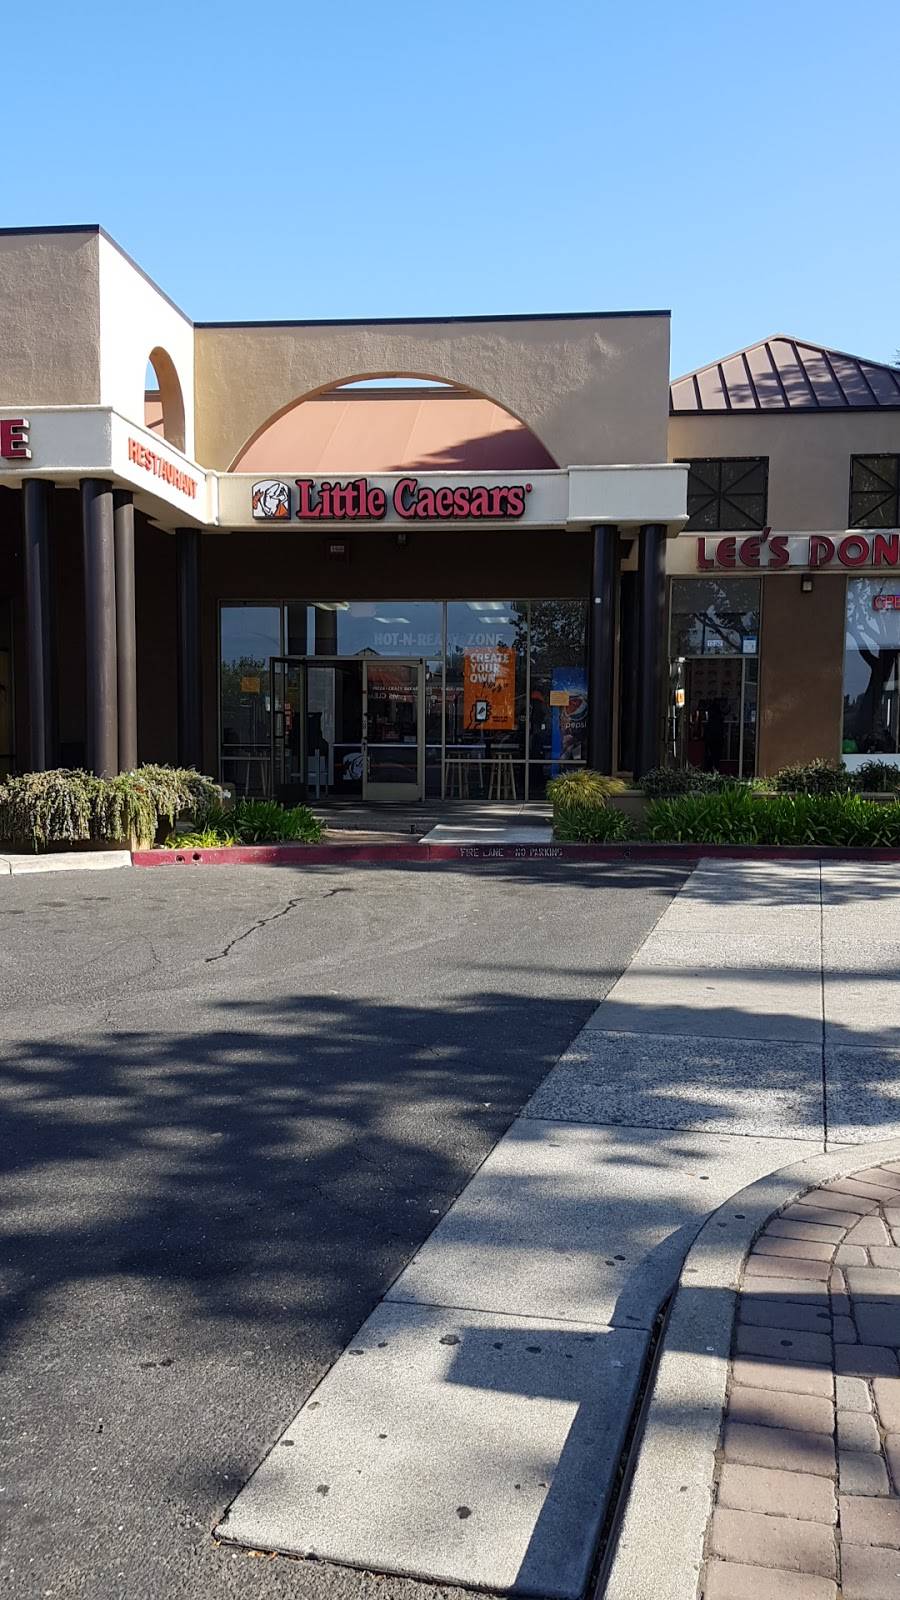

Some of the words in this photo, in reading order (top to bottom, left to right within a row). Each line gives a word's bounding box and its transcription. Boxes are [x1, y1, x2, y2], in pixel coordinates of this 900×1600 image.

[0, 418, 32, 460] E
[128, 437, 198, 500] RESTAURANT
[295, 478, 387, 520] Little
[393, 478, 526, 520] Caesars
[697, 527, 790, 568] LEE'S
[467, 633, 504, 646] ZONE
[470, 653, 509, 663] CREATE
[470, 663, 500, 673] YOUR
[469, 673, 496, 683] OWN
[565, 720, 587, 730] pepsi
[460, 847, 479, 857] FIRE
[482, 847, 504, 857] LANE
[515, 847, 526, 857] NO
[530, 847, 562, 857] PARKING
